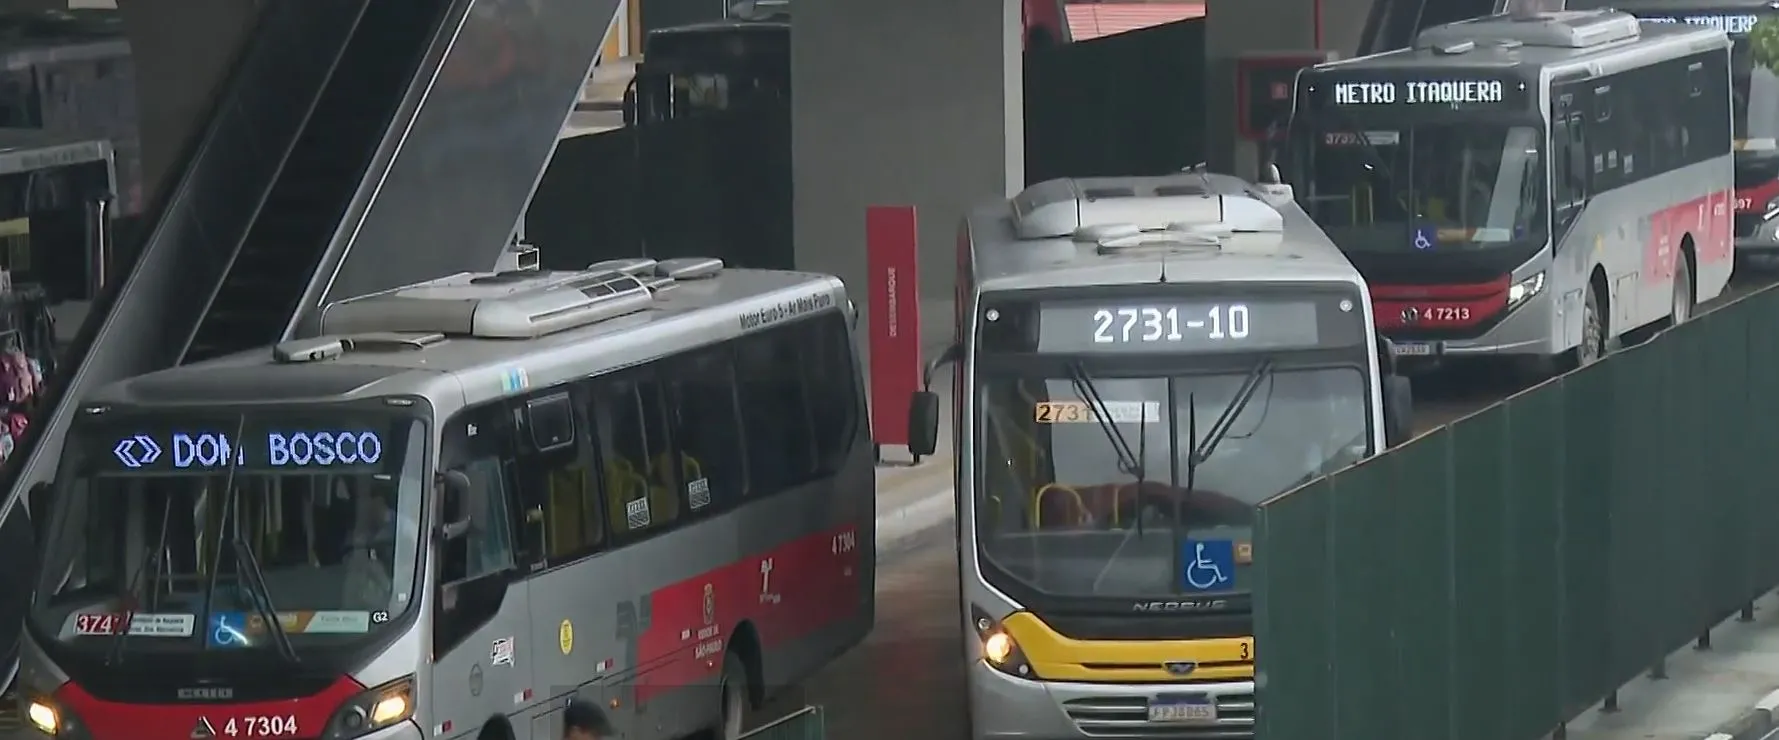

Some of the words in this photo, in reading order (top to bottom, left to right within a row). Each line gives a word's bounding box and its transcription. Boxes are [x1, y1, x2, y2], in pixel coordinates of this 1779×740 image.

[1335, 81, 1396, 104] METRO
[1406, 80, 1503, 103] ITAQUERA
[1092, 304, 1250, 344] 2731-10
[1424, 308, 1433, 320] 4
[1436, 307, 1470, 320] 7213
[173, 432, 244, 468] DOM
[268, 431, 382, 466] BOSCO
[831, 535, 838, 555] 4
[837, 531, 856, 553] 7304
[372, 611, 388, 623] G2
[224, 717, 239, 737] 4
[244, 714, 298, 737] 7304
